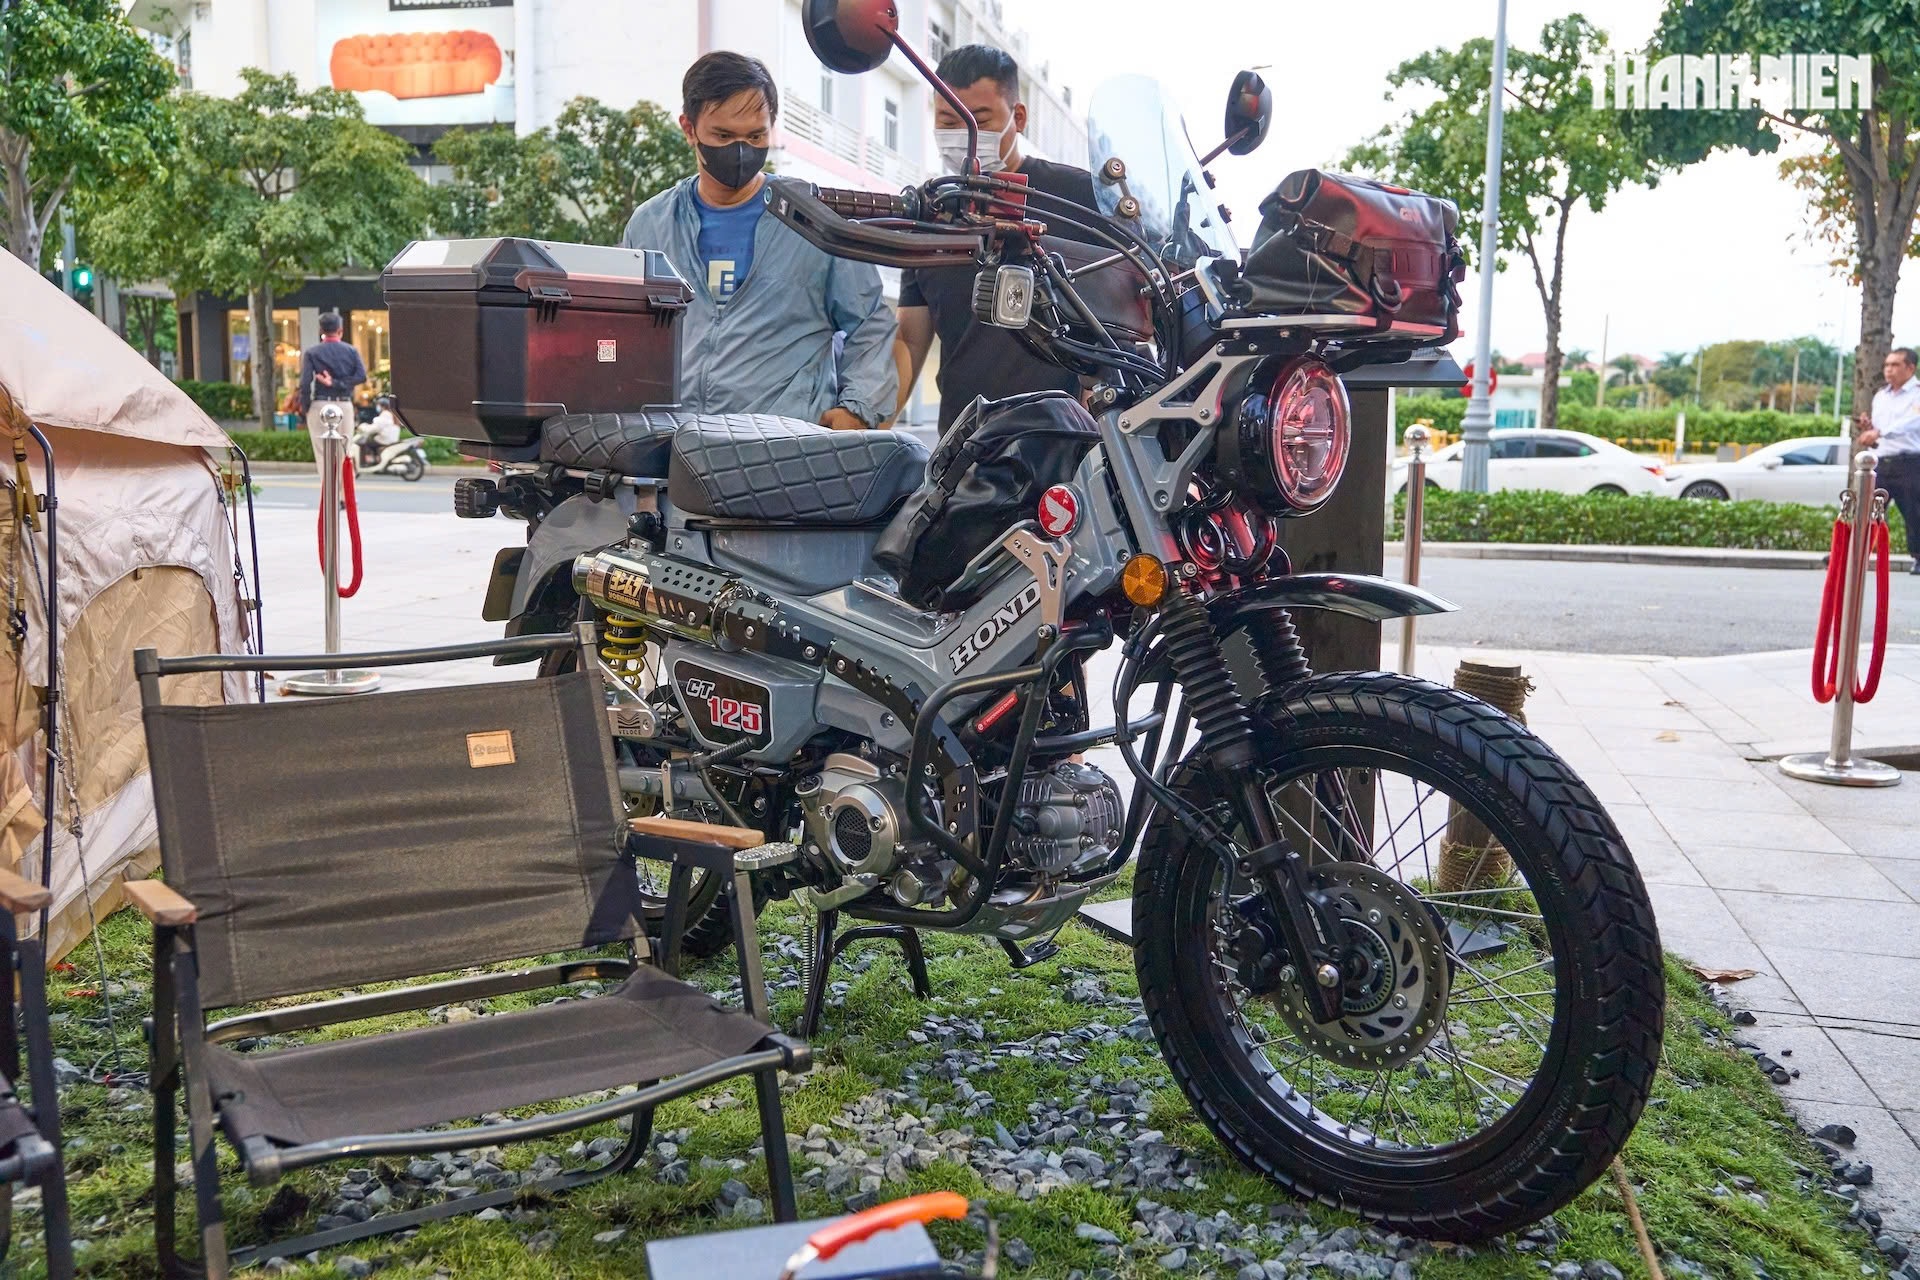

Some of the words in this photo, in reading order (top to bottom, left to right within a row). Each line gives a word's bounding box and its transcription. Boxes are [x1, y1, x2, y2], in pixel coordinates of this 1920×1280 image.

[949, 579, 1041, 675] HOND
[686, 678, 716, 700] CT
[707, 695, 763, 735] 125
